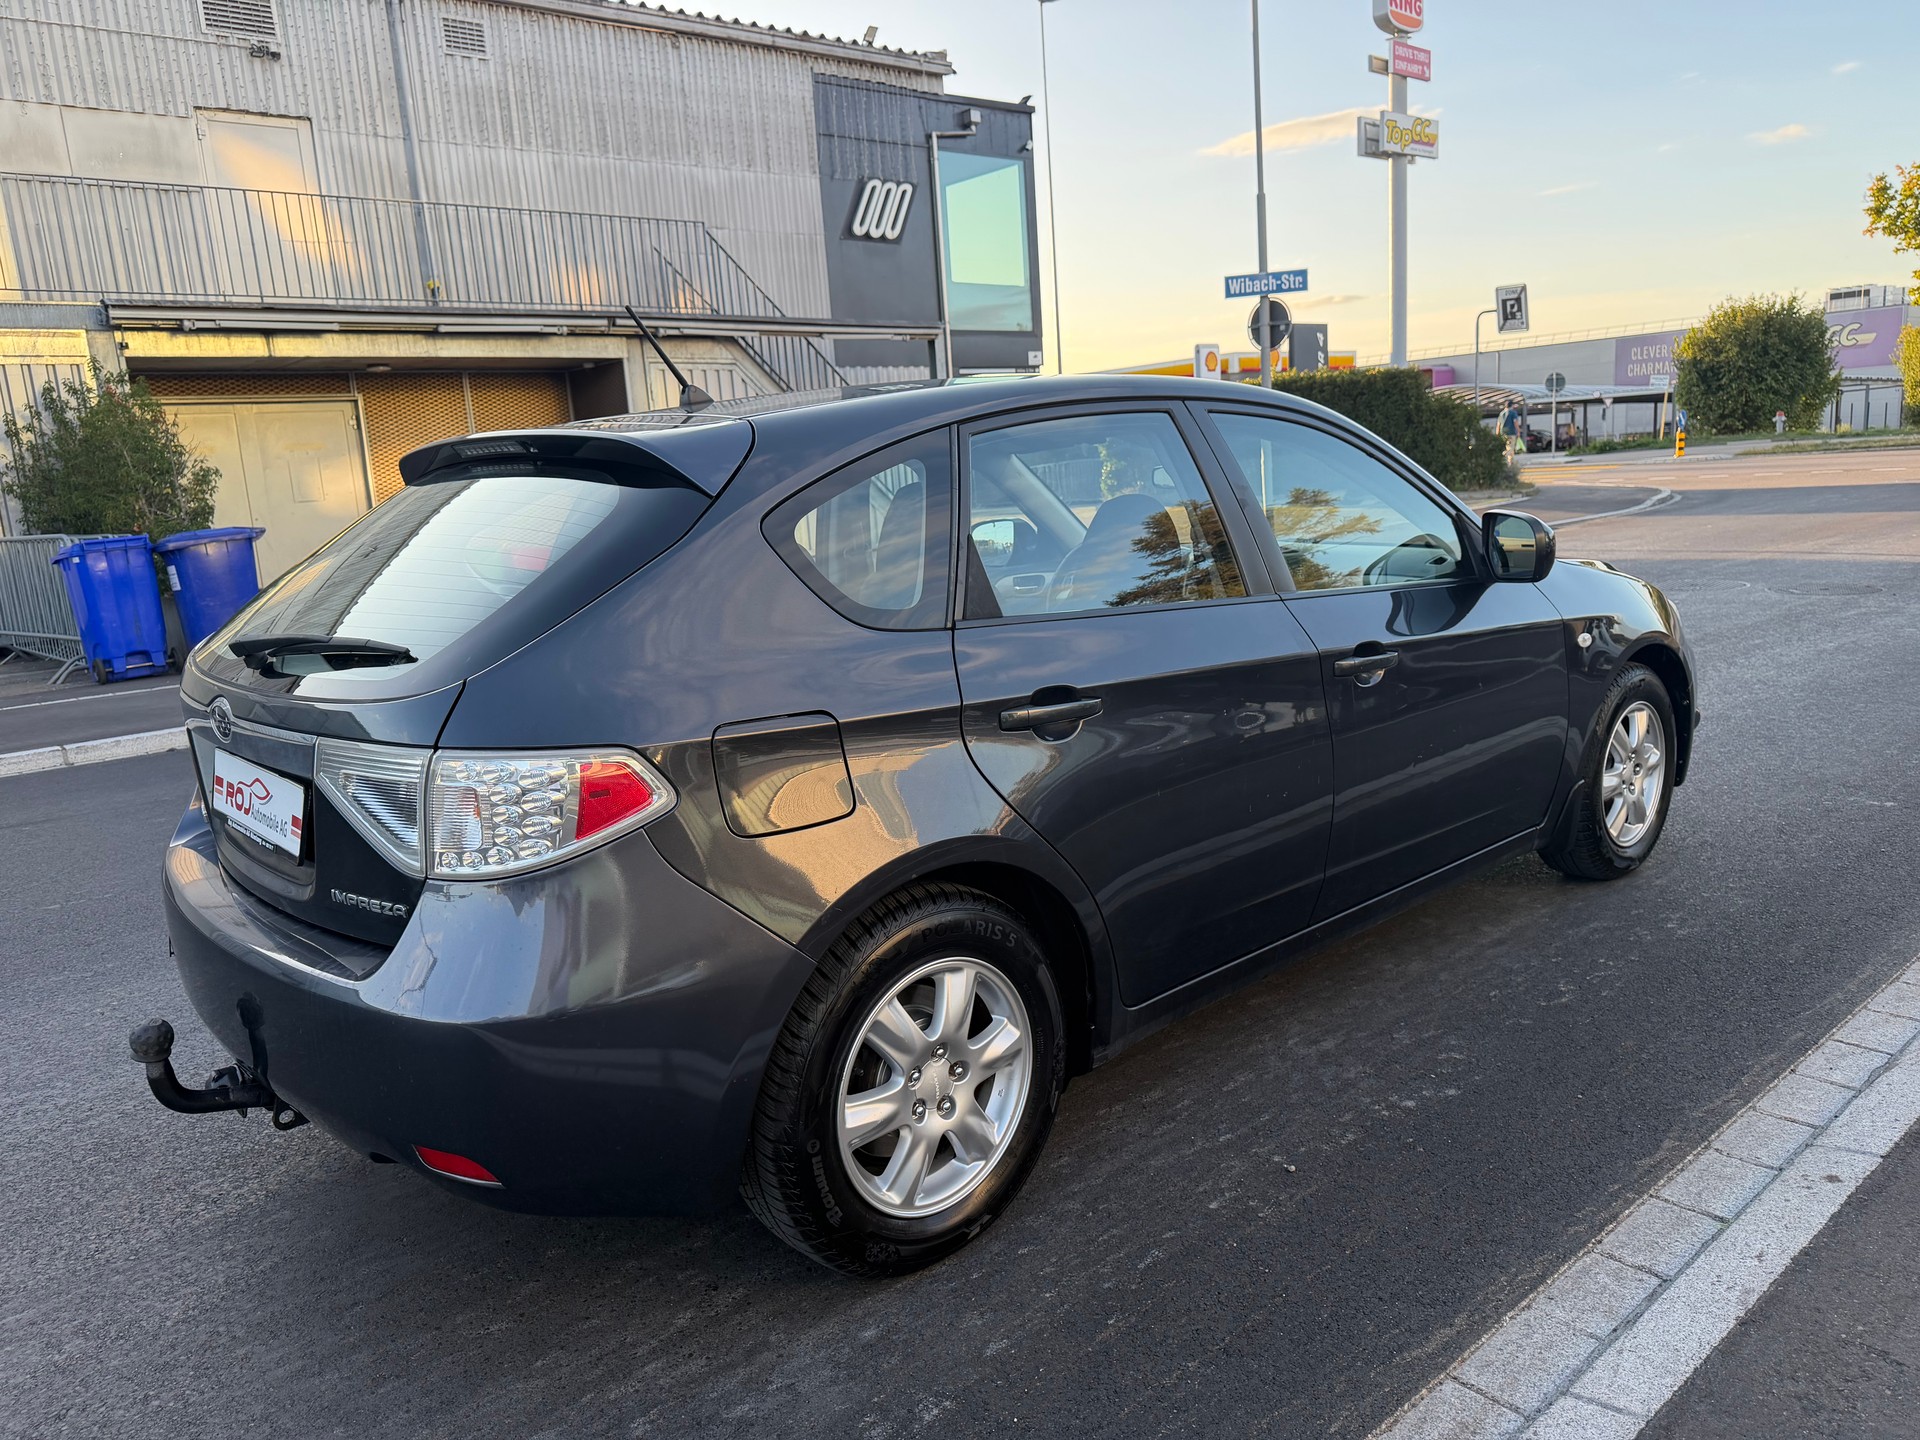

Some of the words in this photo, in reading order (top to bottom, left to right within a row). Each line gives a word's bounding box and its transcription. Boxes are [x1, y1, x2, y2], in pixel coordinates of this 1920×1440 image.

[1395, 45, 1414, 59] DRIVE
[1414, 50, 1429, 63] THRU
[1395, 59, 1422, 74] EINFAHRT
[1228, 274, 1303, 295] Wibach-Str.
[1631, 344, 1668, 360] CLEVER
[225, 780, 252, 816] ROJ
[250, 803, 279, 833] Automobile
[279, 818, 288, 838] AG
[331, 888, 407, 918] IMPREZA
[1006, 931, 1017, 947] 5
